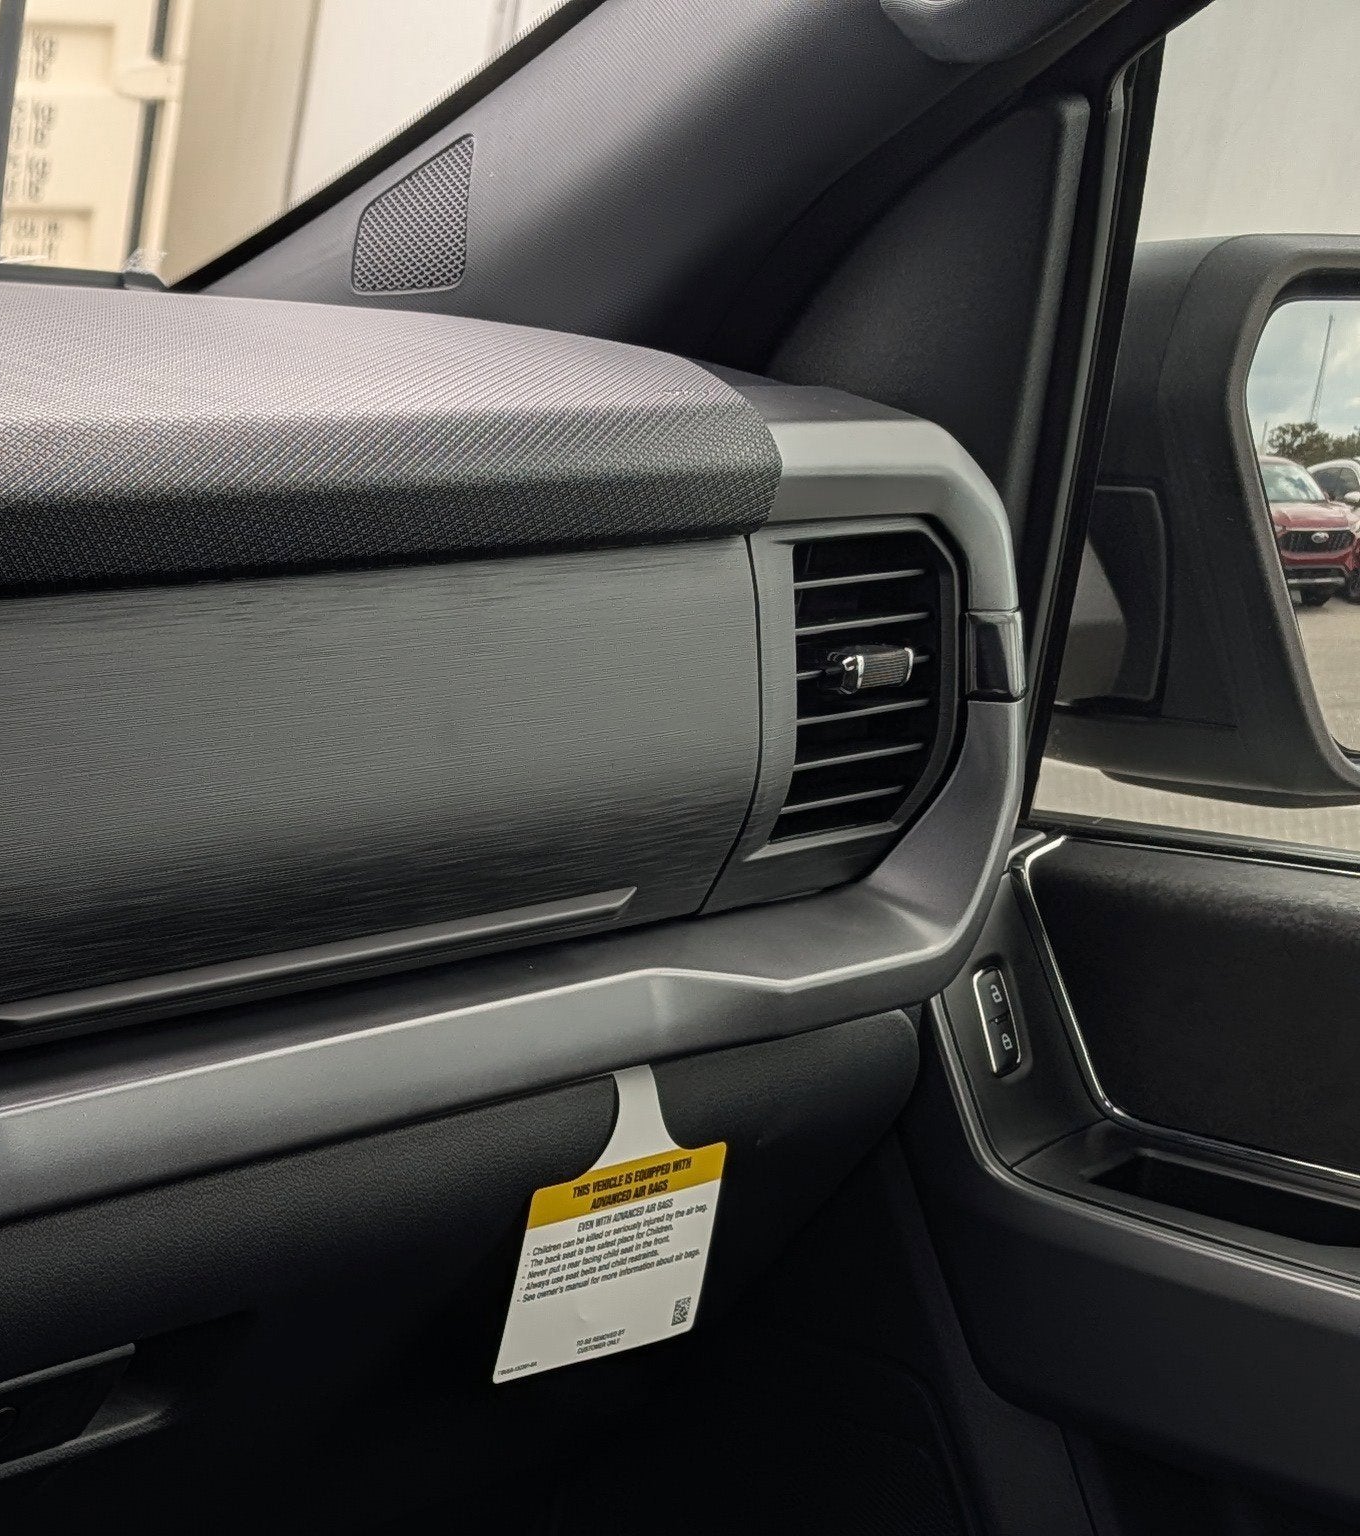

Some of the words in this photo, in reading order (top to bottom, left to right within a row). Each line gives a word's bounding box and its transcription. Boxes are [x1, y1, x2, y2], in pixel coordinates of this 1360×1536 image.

[573, 1183, 591, 1199] THIS
[592, 1174, 624, 1193] VEHICLE
[625, 1172, 633, 1185] IS
[634, 1162, 671, 1182] EQUIPPED
[672, 1156, 693, 1172] WITH
[590, 1189, 631, 1210] ADVANCED
[632, 1185, 647, 1199] AIR
[648, 1179, 669, 1196] BAGS
[612, 1206, 645, 1222] ADVANCED
